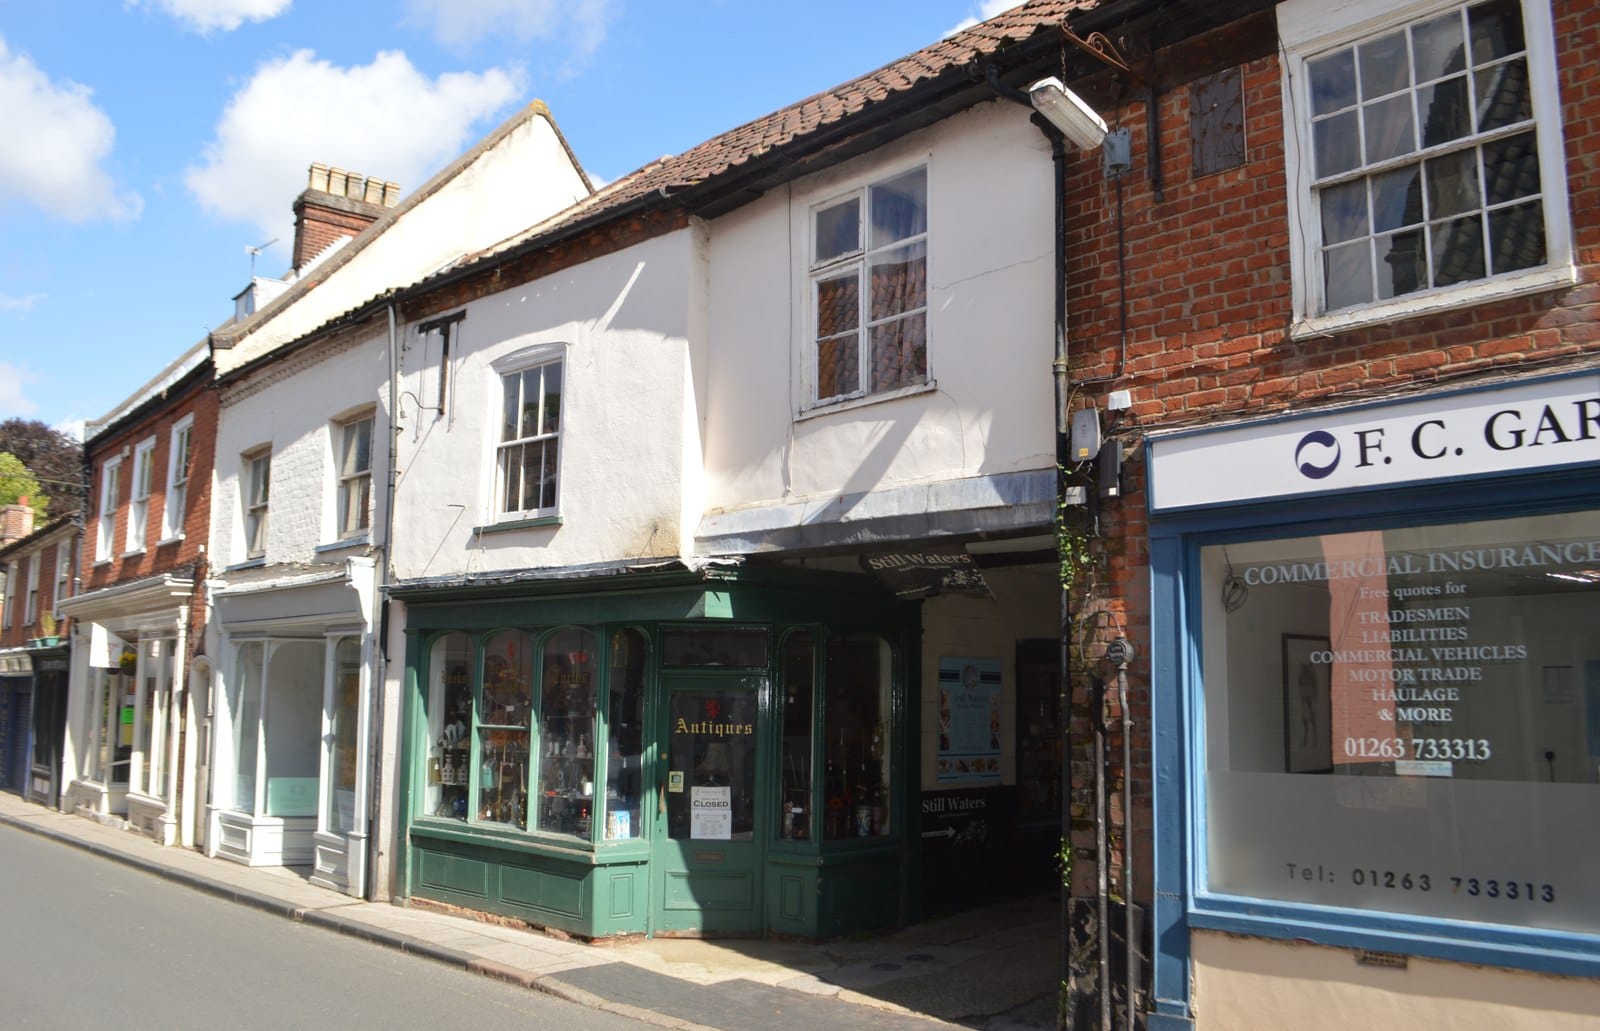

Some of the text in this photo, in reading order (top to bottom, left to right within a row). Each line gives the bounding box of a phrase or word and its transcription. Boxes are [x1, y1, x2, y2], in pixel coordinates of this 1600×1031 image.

[1354, 428, 1392, 468] F.
[1411, 420, 1464, 459] C.
[868, 553, 906, 570] Still
[905, 553, 971, 566] Waters
[1244, 542, 1600, 585] COMMERCIAL INSURANCE
[1359, 582, 1467, 600] Free quotes for
[1358, 606, 1471, 625] TRADESMEN
[1362, 626, 1468, 644] LIABILITIES
[1310, 645, 1528, 664] COMMERCIAL VEHICLES
[1350, 667, 1483, 682] MOTOR TRADE
[1372, 687, 1460, 702] HAULAGE
[1379, 707, 1453, 722] & MORE
[675, 718, 754, 738] Antiques
[1344, 737, 1492, 760] 01263 733313
[693, 799, 729, 809] CLOSED
[921, 797, 986, 813] Still Waters
[1286, 864, 1556, 903] Tel: 01263 733313
